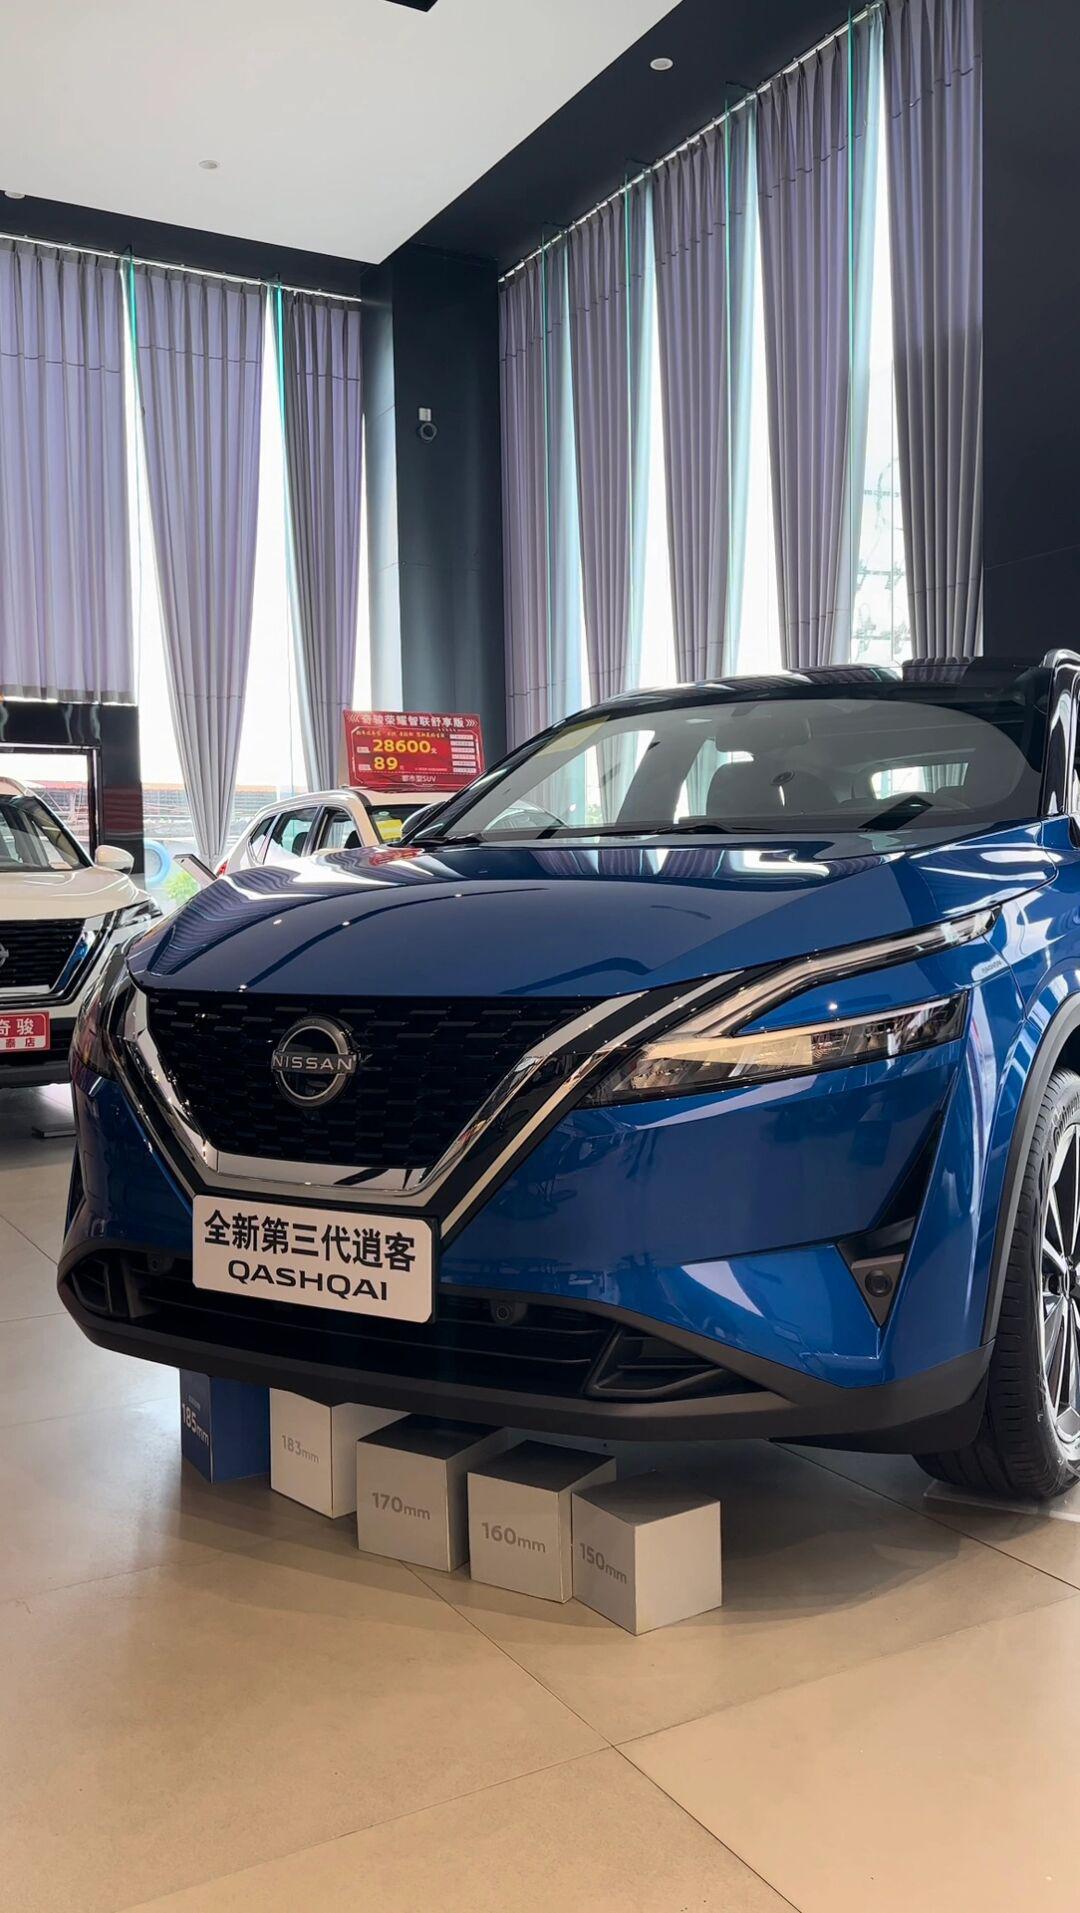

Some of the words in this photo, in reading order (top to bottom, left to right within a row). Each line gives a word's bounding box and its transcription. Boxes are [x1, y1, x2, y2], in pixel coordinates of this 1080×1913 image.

[272, 1055, 352, 1071] NISSAN
[204, 1209, 416, 1272] 全新第三代逍客
[228, 1259, 388, 1301] QASHQAI
[181, 1402, 209, 1447] 185mm
[281, 1434, 320, 1464] 183mm
[372, 1492, 431, 1521] 170mm
[481, 1522, 546, 1554] 160mm
[579, 1542, 627, 1585] 150mm
